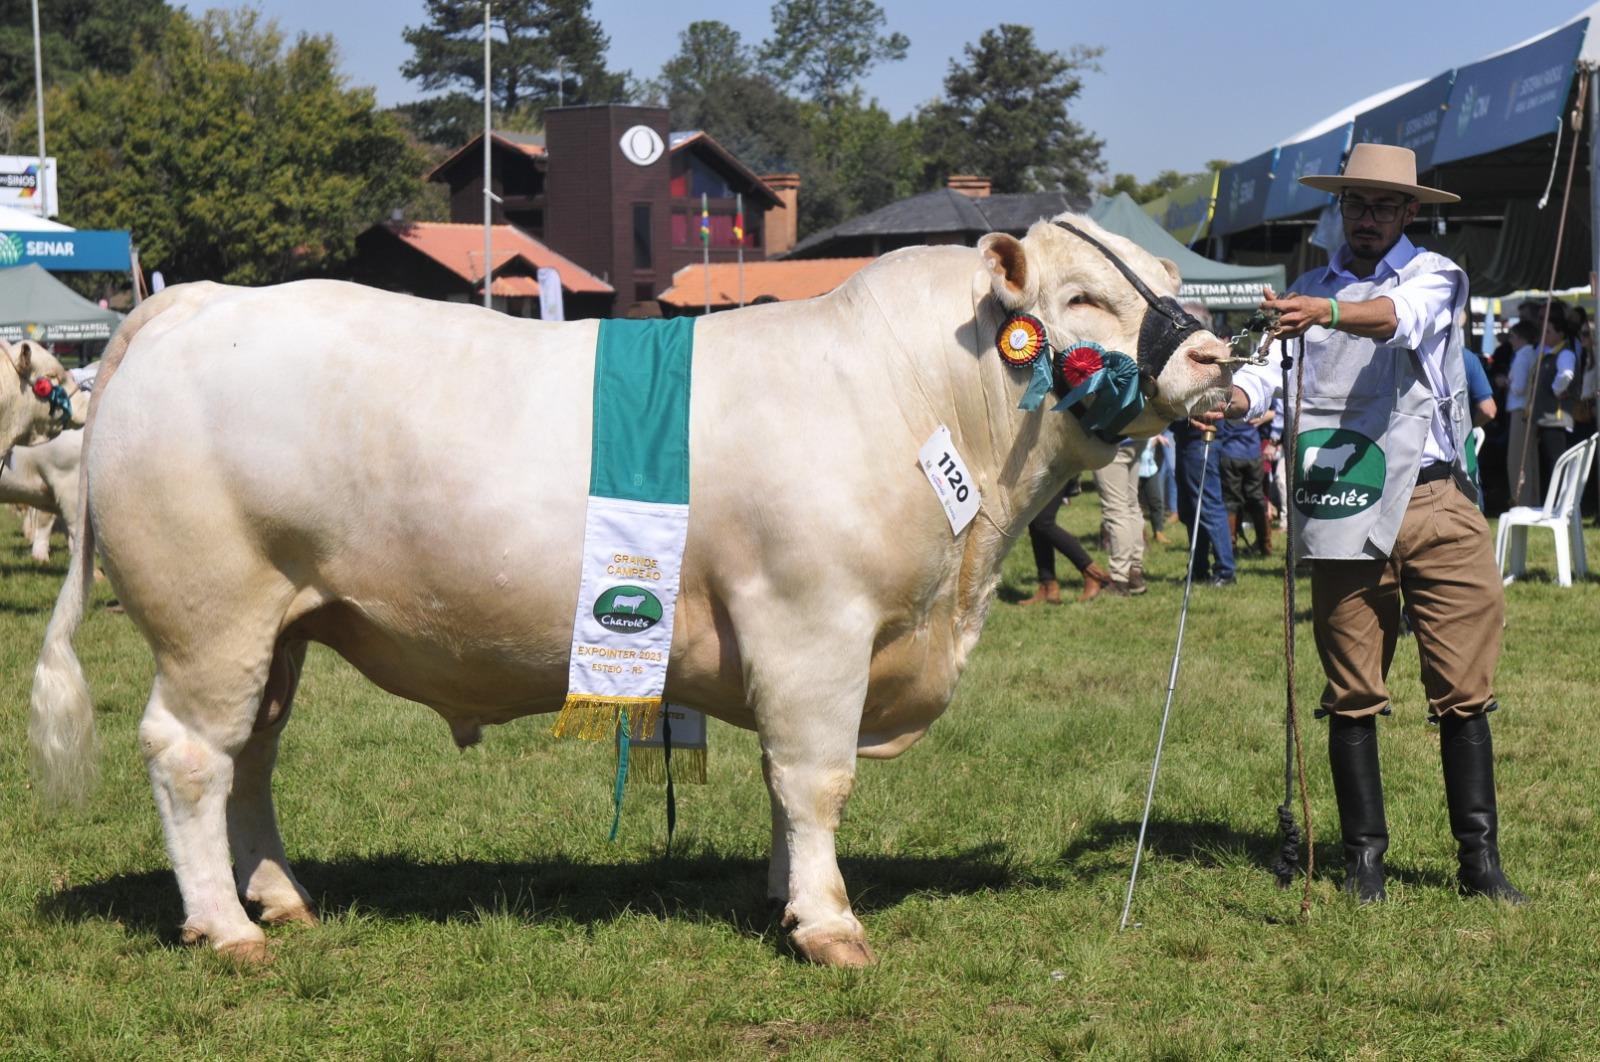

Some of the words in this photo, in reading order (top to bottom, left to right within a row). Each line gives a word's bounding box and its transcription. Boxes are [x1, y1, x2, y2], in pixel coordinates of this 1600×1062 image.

[7, 174, 36, 187] SINOS
[26, 241, 75, 256] SENAR
[1179, 284, 1228, 296] SISTEMA
[938, 451, 969, 503] 1120
[1295, 487, 1369, 507] Charolês
[613, 554, 658, 569] GRANDE
[601, 614, 649, 628] Charolês
[578, 646, 636, 659] EXPOINTER
[639, 650, 662, 662] 2023
[592, 663, 622, 673] ESTEIO
[632, 666, 644, 674] RS
